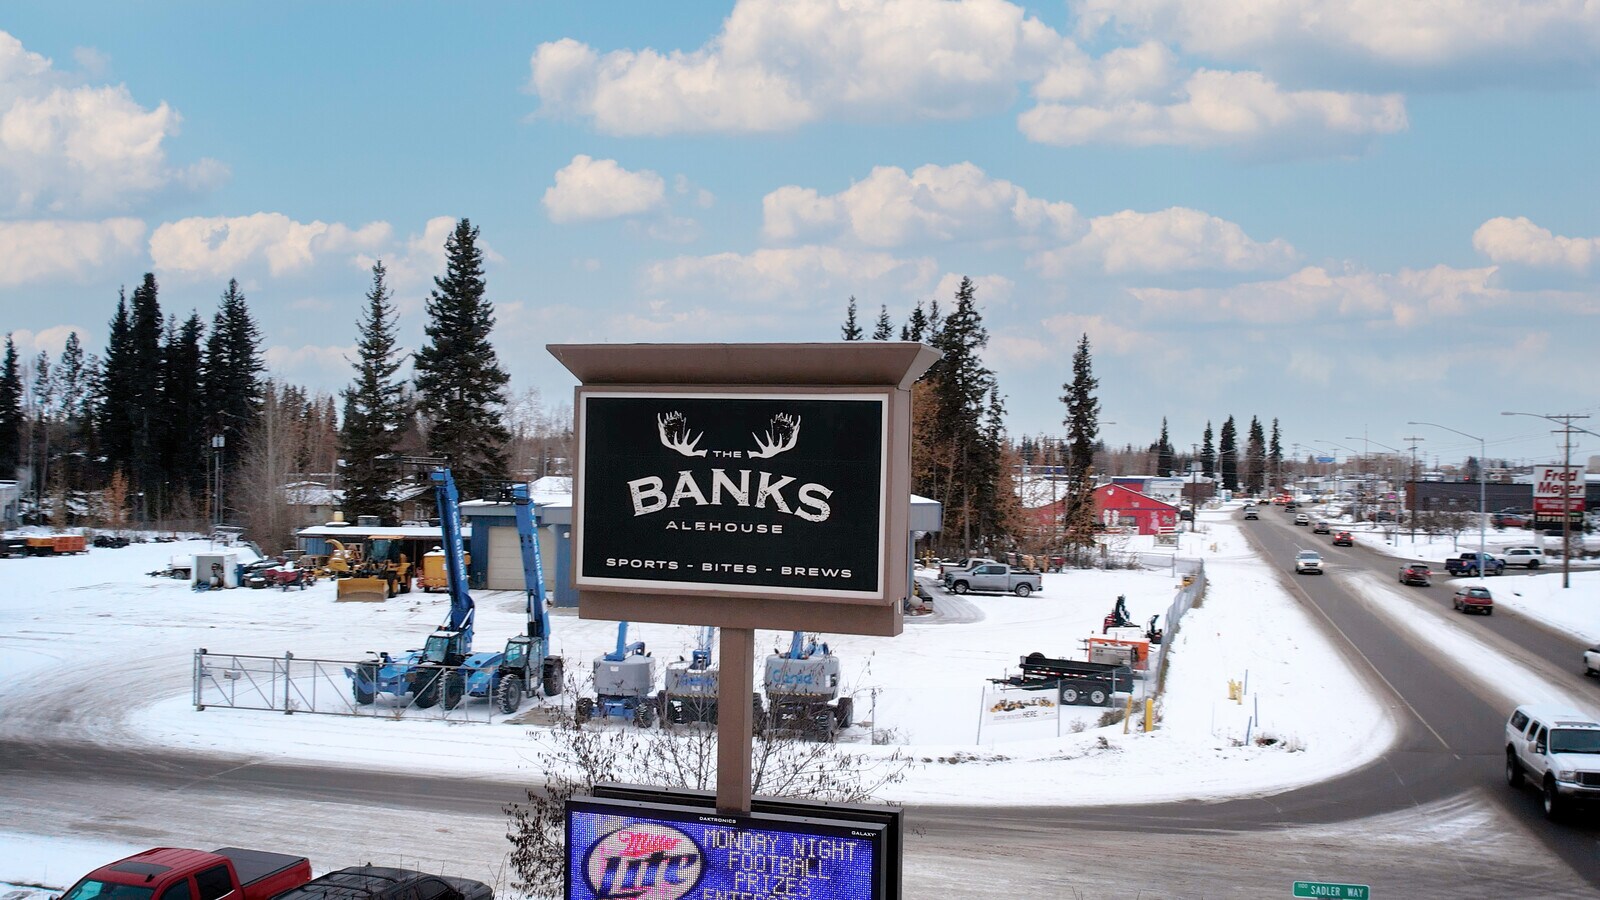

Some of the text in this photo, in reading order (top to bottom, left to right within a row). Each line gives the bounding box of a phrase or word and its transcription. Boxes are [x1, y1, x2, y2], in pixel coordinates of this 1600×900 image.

[713, 450, 742, 458] THE
[1544, 470, 1577, 481] Fred
[627, 468, 834, 523] BANKS
[1537, 482, 1583, 496] Meyer
[665, 520, 784, 534] ALEHOUSE
[606, 558, 679, 570] SPORTS
[702, 562, 758, 573] BITES
[781, 566, 852, 579] BREWS
[698, 816, 737, 824] DAKTRONICS
[618, 831, 683, 858] Miller
[704, 828, 857, 861] MONDAY NIGHT
[729, 851, 830, 879] FOOTBALL
[735, 871, 811, 897] PRIZES
[1311, 886, 1340, 896] SADLER
[1347, 888, 1364, 897] WAY
